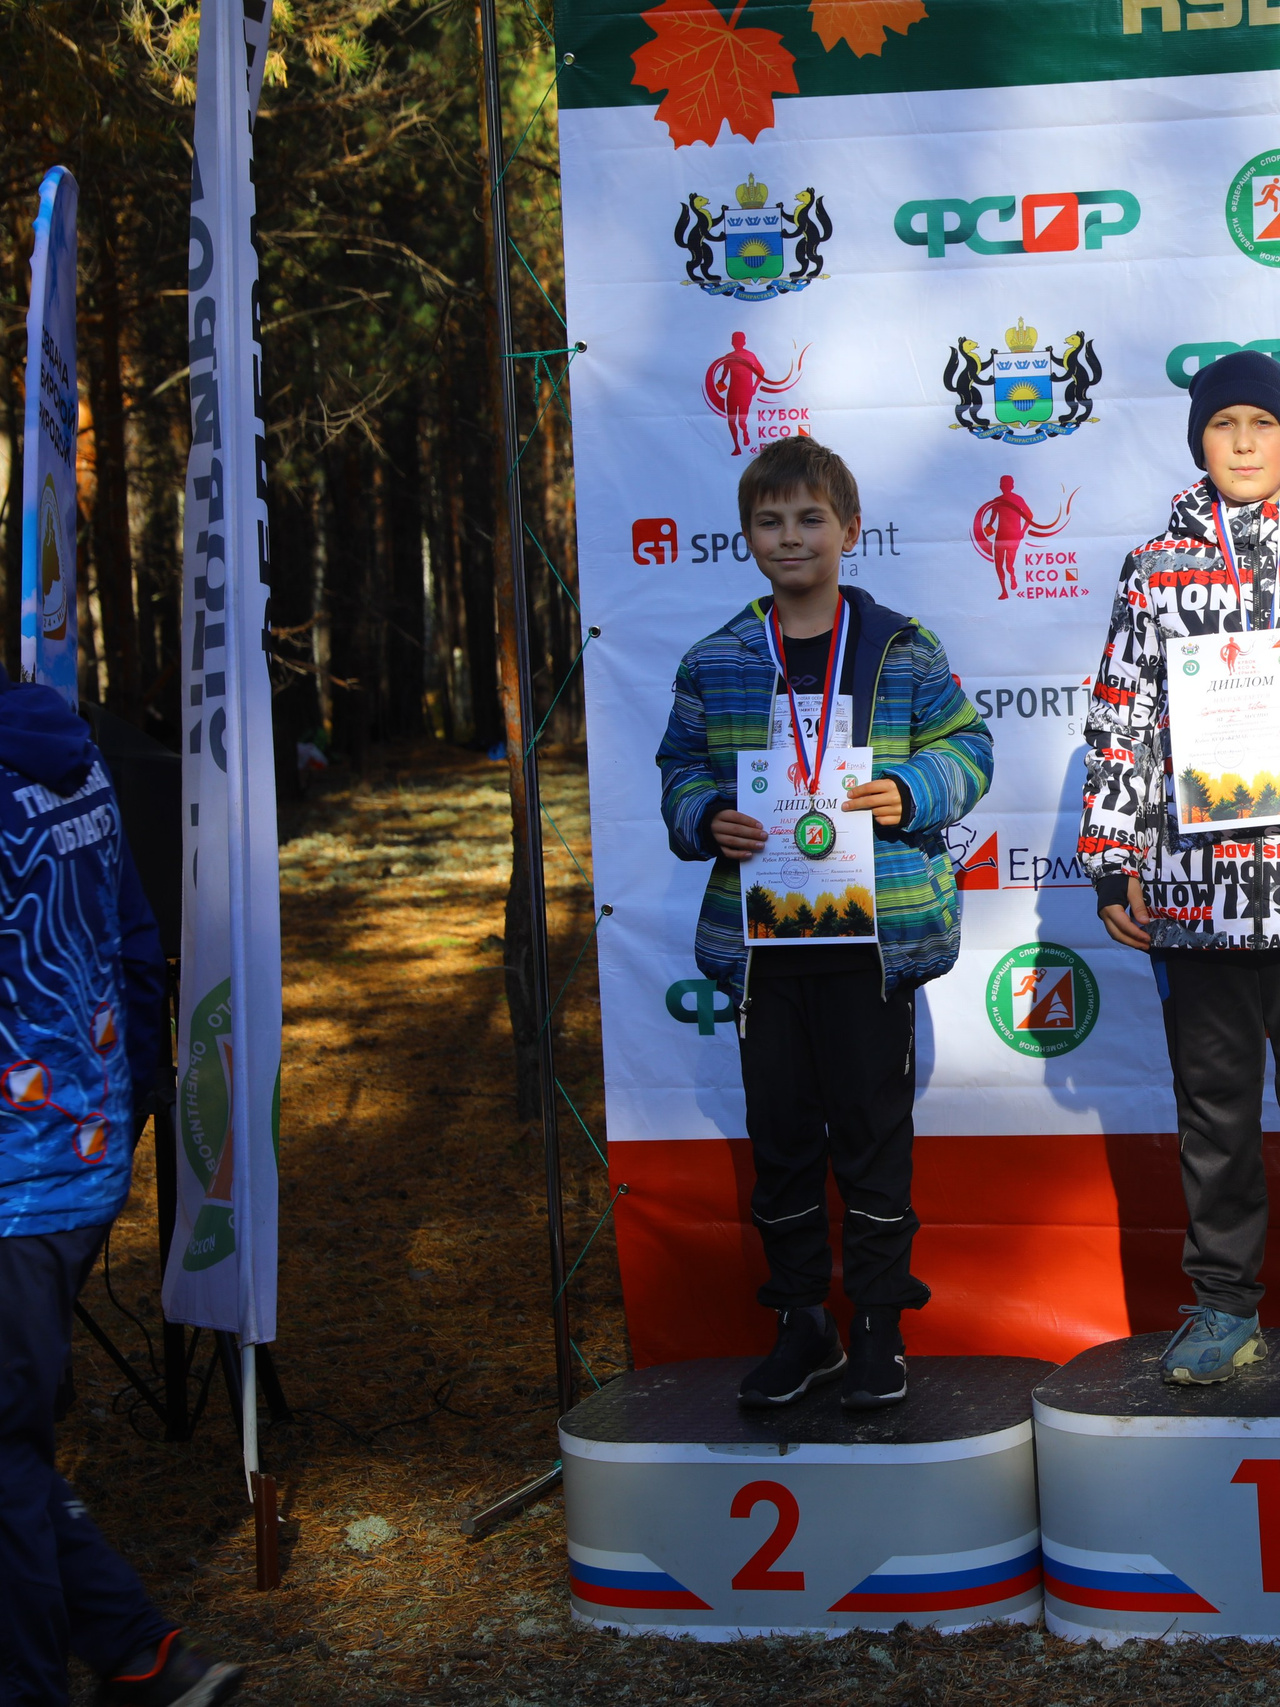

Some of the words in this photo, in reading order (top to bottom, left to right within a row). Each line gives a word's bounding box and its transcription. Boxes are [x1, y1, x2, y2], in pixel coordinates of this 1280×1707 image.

[1231, 166, 1257, 213] ФЕДЕРАЦИЯ
[1231, 217, 1255, 252] ОБЛАСТИ
[757, 408, 810, 422] КУБОК
[758, 425, 791, 438] КСО
[1024, 551, 1077, 566] КУБОК
[1025, 569, 1059, 583] КСО
[1016, 585, 1089, 599] «ЕРМАК»
[1207, 675, 1275, 693] ДИПЛОМ
[1019, 947, 1075, 964] СПОРТИВНОГО
[991, 957, 1016, 1002] ФЕДЕРАЦИЯ
[1073, 968, 1095, 1040] ОРИЕНТИРОВАНИЯ
[992, 1006, 1015, 1040] ОБЛАСТИ
[1018, 1040, 1069, 1053] ТЮМЕНСКОЙ
[730, 1482, 805, 1593] 2
